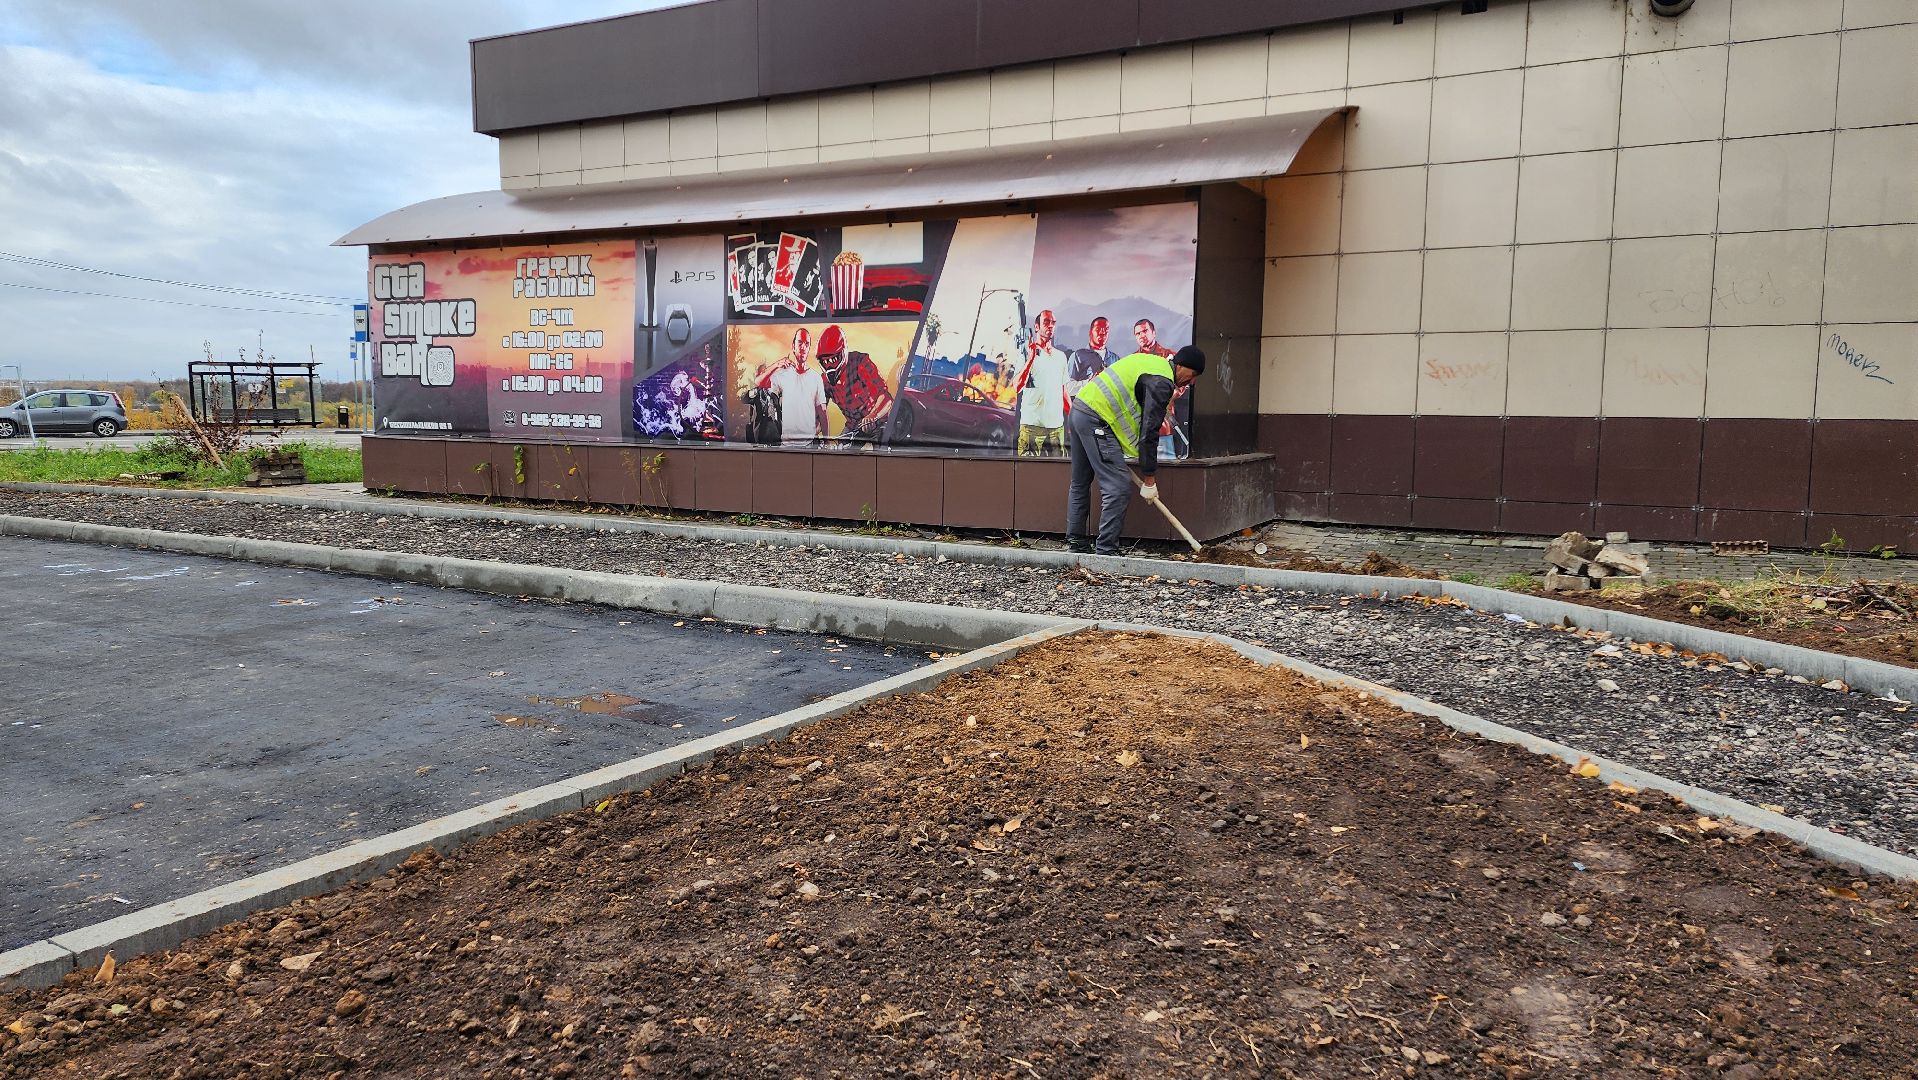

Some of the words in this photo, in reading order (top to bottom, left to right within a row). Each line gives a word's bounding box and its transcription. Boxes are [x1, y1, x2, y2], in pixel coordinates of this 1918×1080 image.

[686, 271, 716, 281] PS5
[512, 331, 545, 348] 16:00
[562, 330, 604, 348] 02:00
[511, 375, 545, 392] 16:00
[562, 375, 603, 393] 04:00
